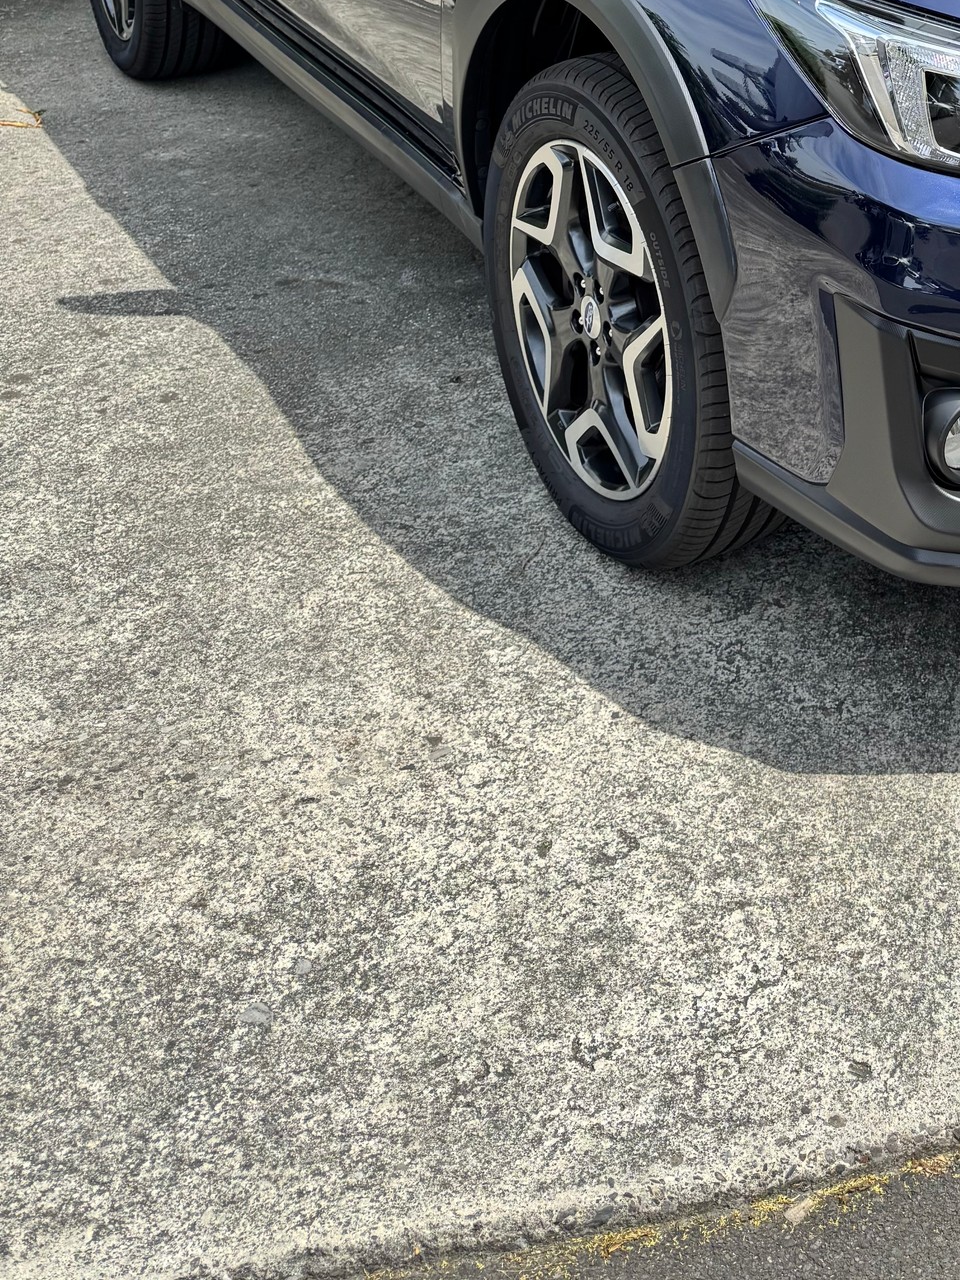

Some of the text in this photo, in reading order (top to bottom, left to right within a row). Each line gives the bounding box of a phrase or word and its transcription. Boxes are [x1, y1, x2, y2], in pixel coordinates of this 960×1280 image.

[512, 97, 573, 132] MICHELIN
[583, 120, 634, 192] 225/55 R 18
[650, 232, 671, 288] OUTSIDE
[571, 511, 642, 549] MICHELIN
